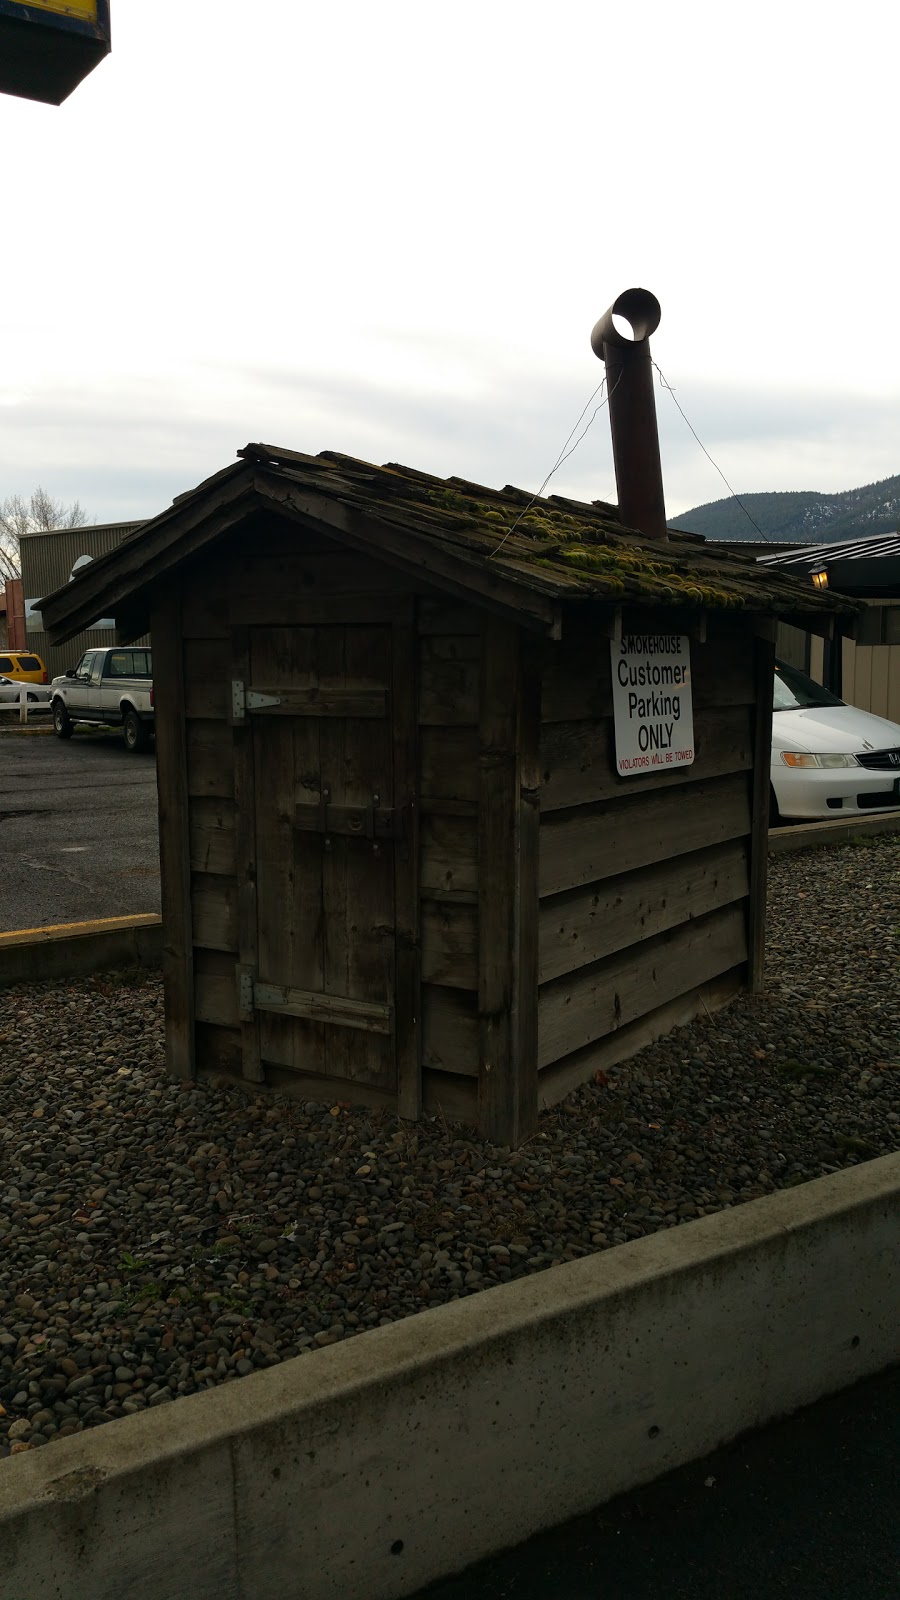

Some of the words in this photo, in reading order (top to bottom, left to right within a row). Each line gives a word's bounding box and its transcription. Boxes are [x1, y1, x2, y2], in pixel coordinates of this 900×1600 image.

[620, 636, 681, 655] SMOKEHOUSE
[617, 659, 687, 687] Customer
[628, 691, 681, 720] Parking
[638, 723, 674, 752] ONLY
[619, 756, 650, 770] VIOLATORS
[651, 754, 664, 765] WILL
[666, 752, 673, 763] BE
[675, 750, 693, 761] TOWED
